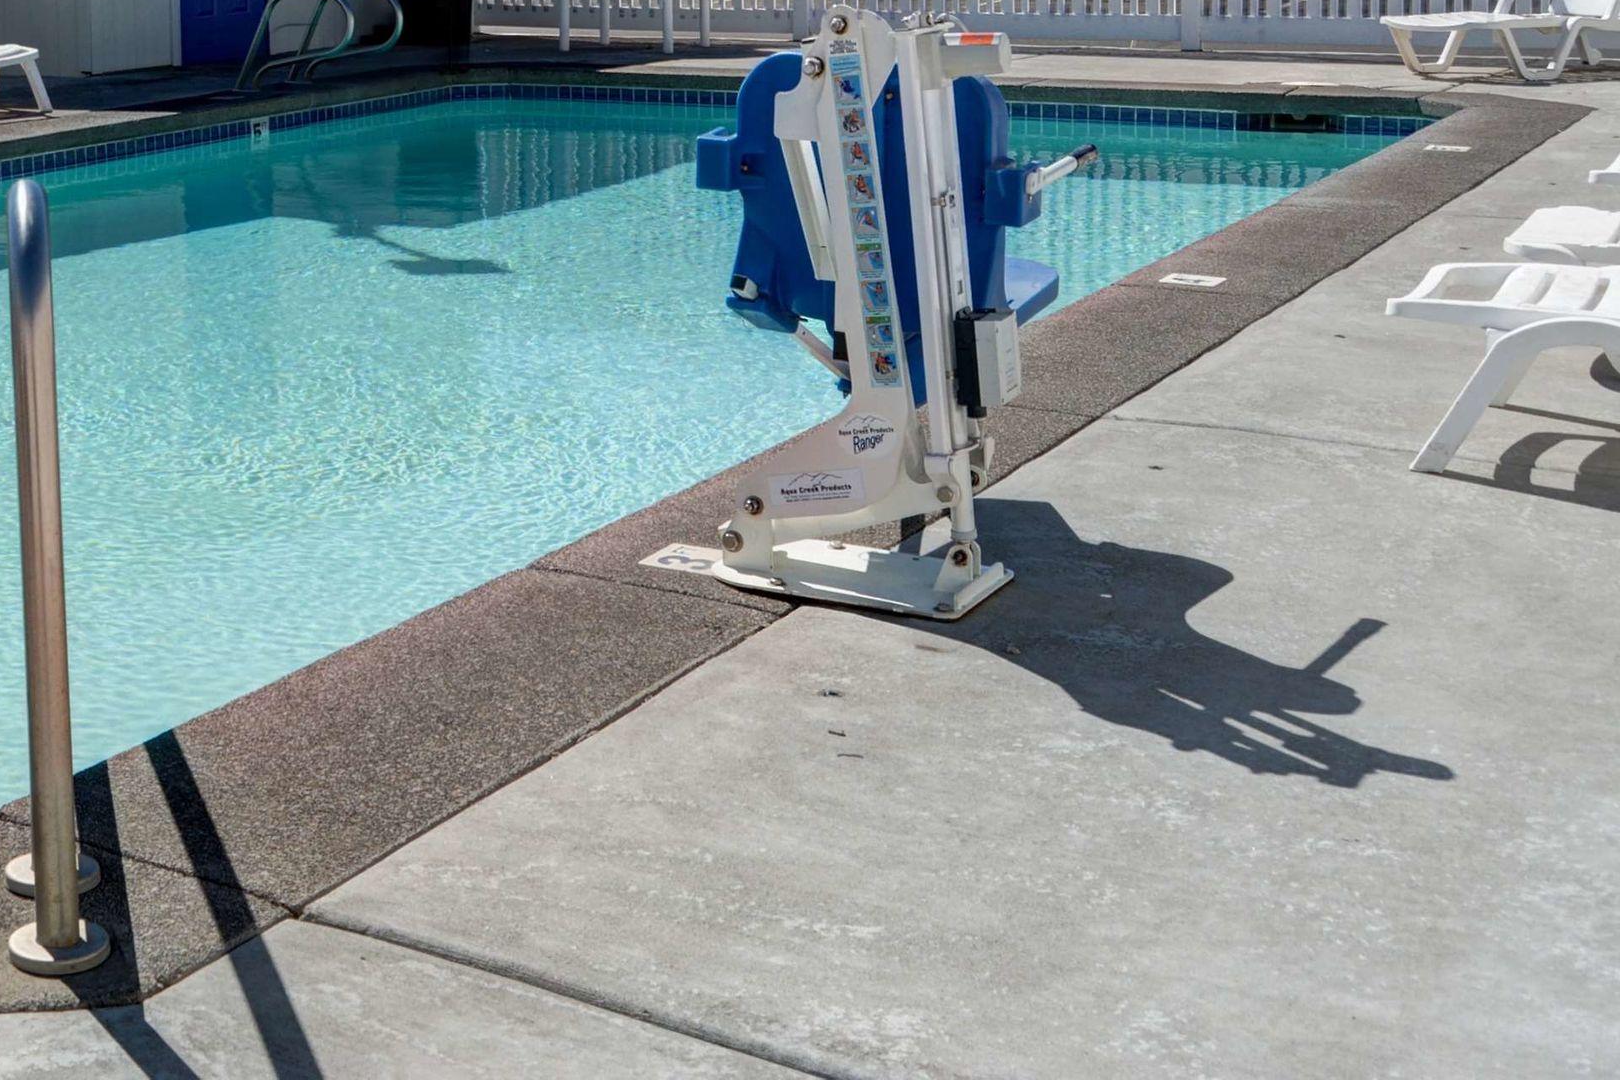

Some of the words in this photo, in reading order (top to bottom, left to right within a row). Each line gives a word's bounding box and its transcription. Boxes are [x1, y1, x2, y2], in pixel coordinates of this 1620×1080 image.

[853, 426, 868, 435] Creek
[870, 426, 894, 434] Products
[852, 432, 884, 455] Ranger
[780, 488, 797, 496] Aqua
[798, 484, 819, 495] Creek
[820, 483, 852, 492] Products
